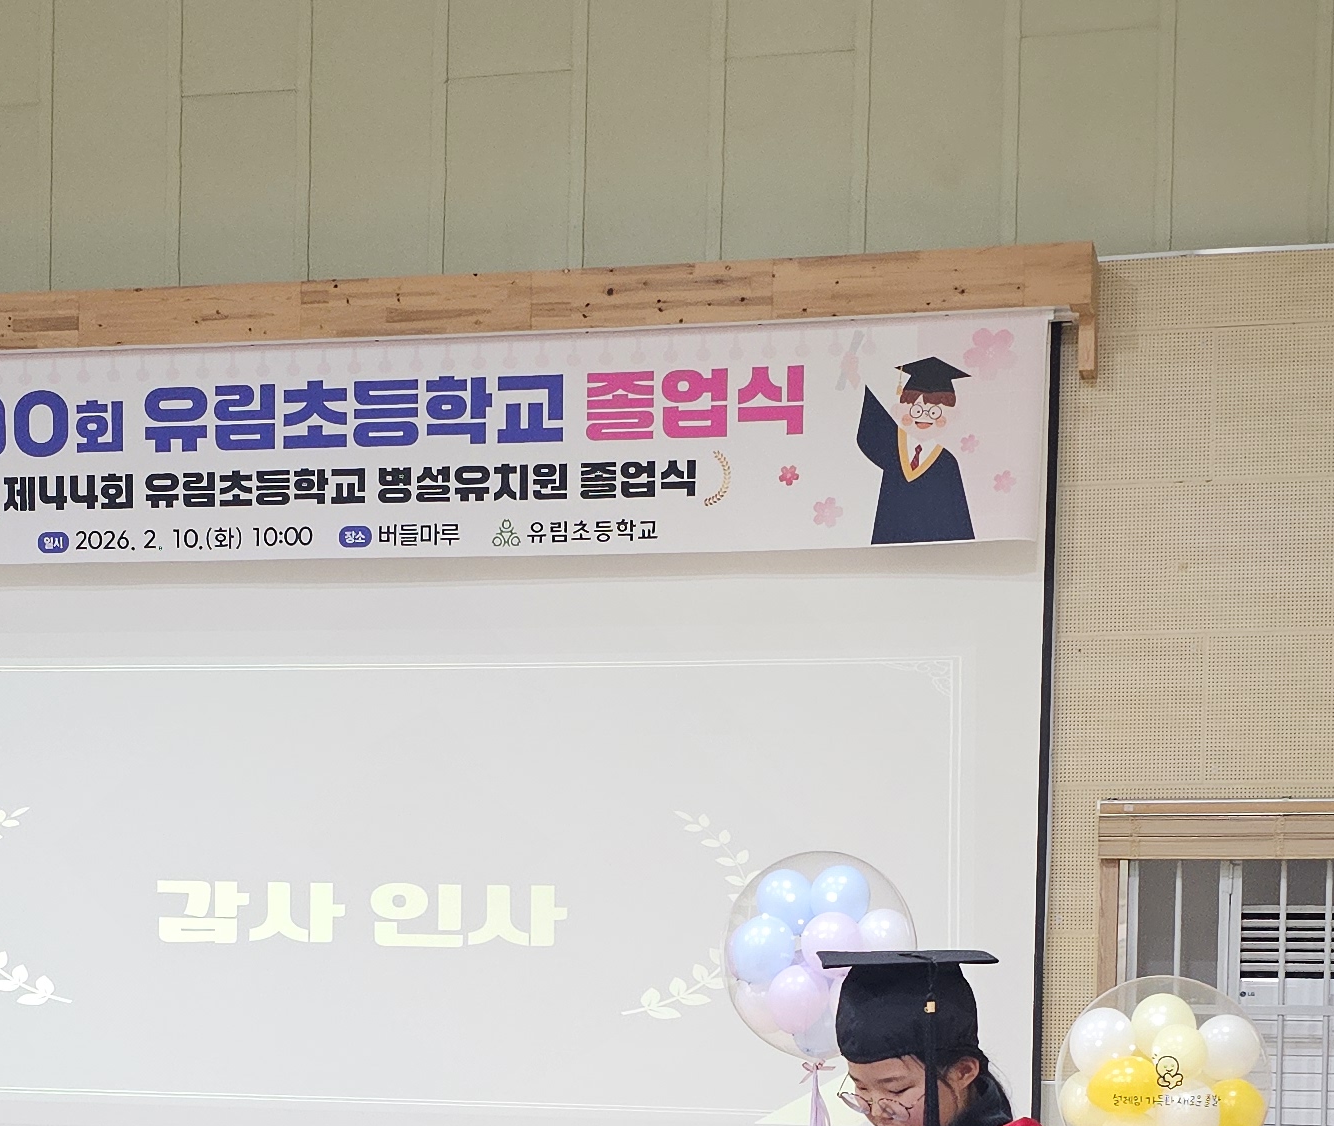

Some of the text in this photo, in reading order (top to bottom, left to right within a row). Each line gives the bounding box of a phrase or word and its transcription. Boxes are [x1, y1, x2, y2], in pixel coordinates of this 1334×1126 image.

[144, 374, 564, 453] 유림초등학교
[585, 365, 804, 441] 졸업식
[3, 459, 697, 512] 제44회 유림초등학교 병설유치원 졸업식
[43, 537, 63, 550] 일시
[75, 530, 136, 551] 2026.
[253, 526, 313, 546] 10:00
[344, 531, 366, 544] 장소
[378, 523, 460, 546] 버들마루
[527, 518, 658, 543] 유림초등학교
[157, 880, 567, 948] 감사 인사
